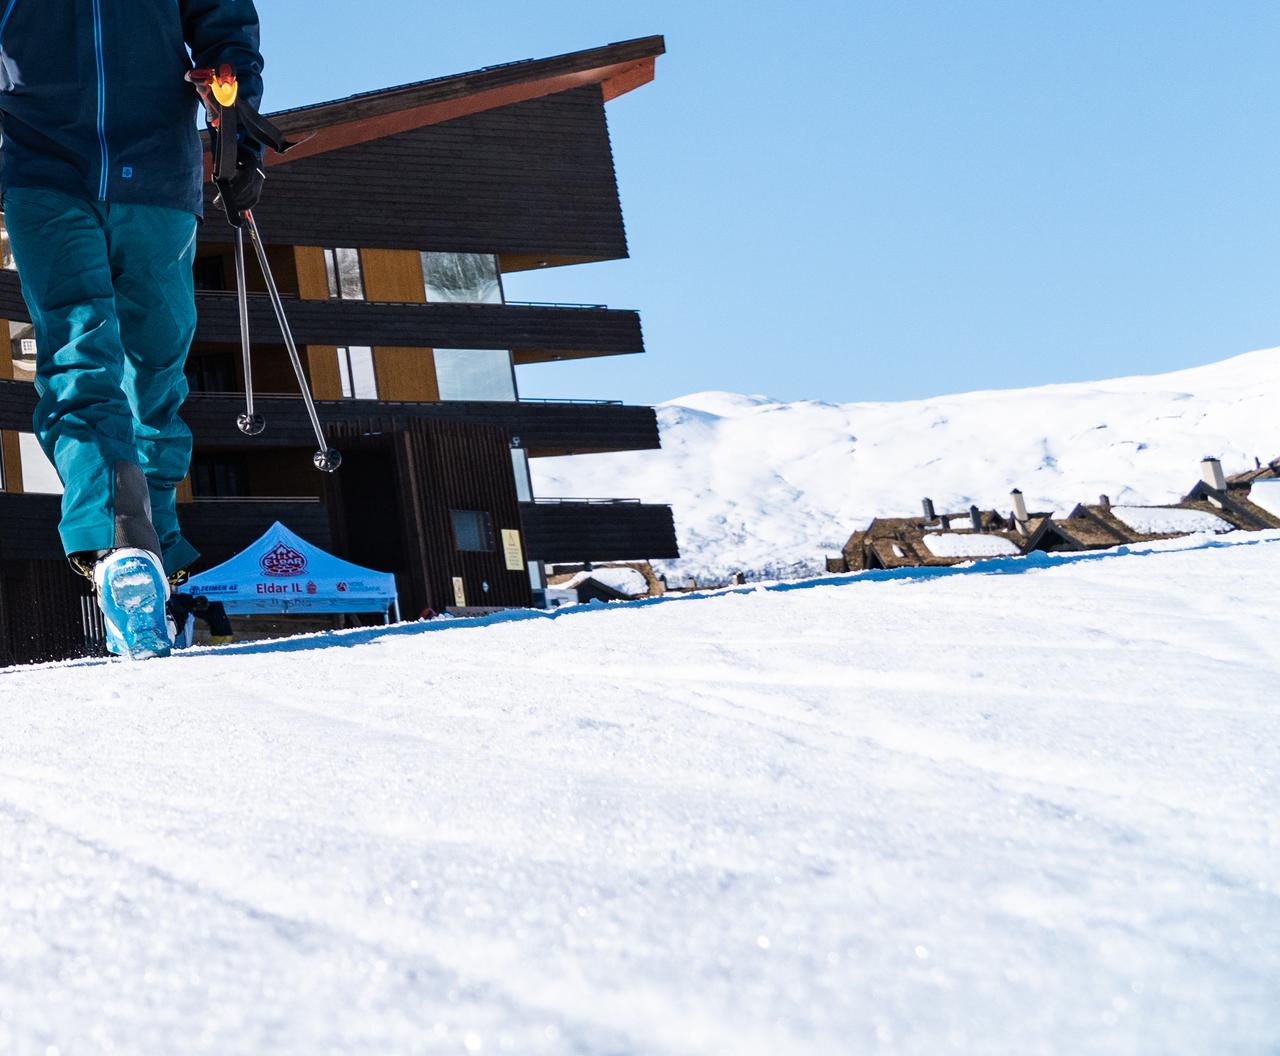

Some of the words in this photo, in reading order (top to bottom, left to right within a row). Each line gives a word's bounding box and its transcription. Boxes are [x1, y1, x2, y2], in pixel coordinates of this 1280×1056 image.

[264, 557, 302, 566] ELDAR
[256, 583, 288, 594] Eldar
[291, 583, 303, 593] IL
